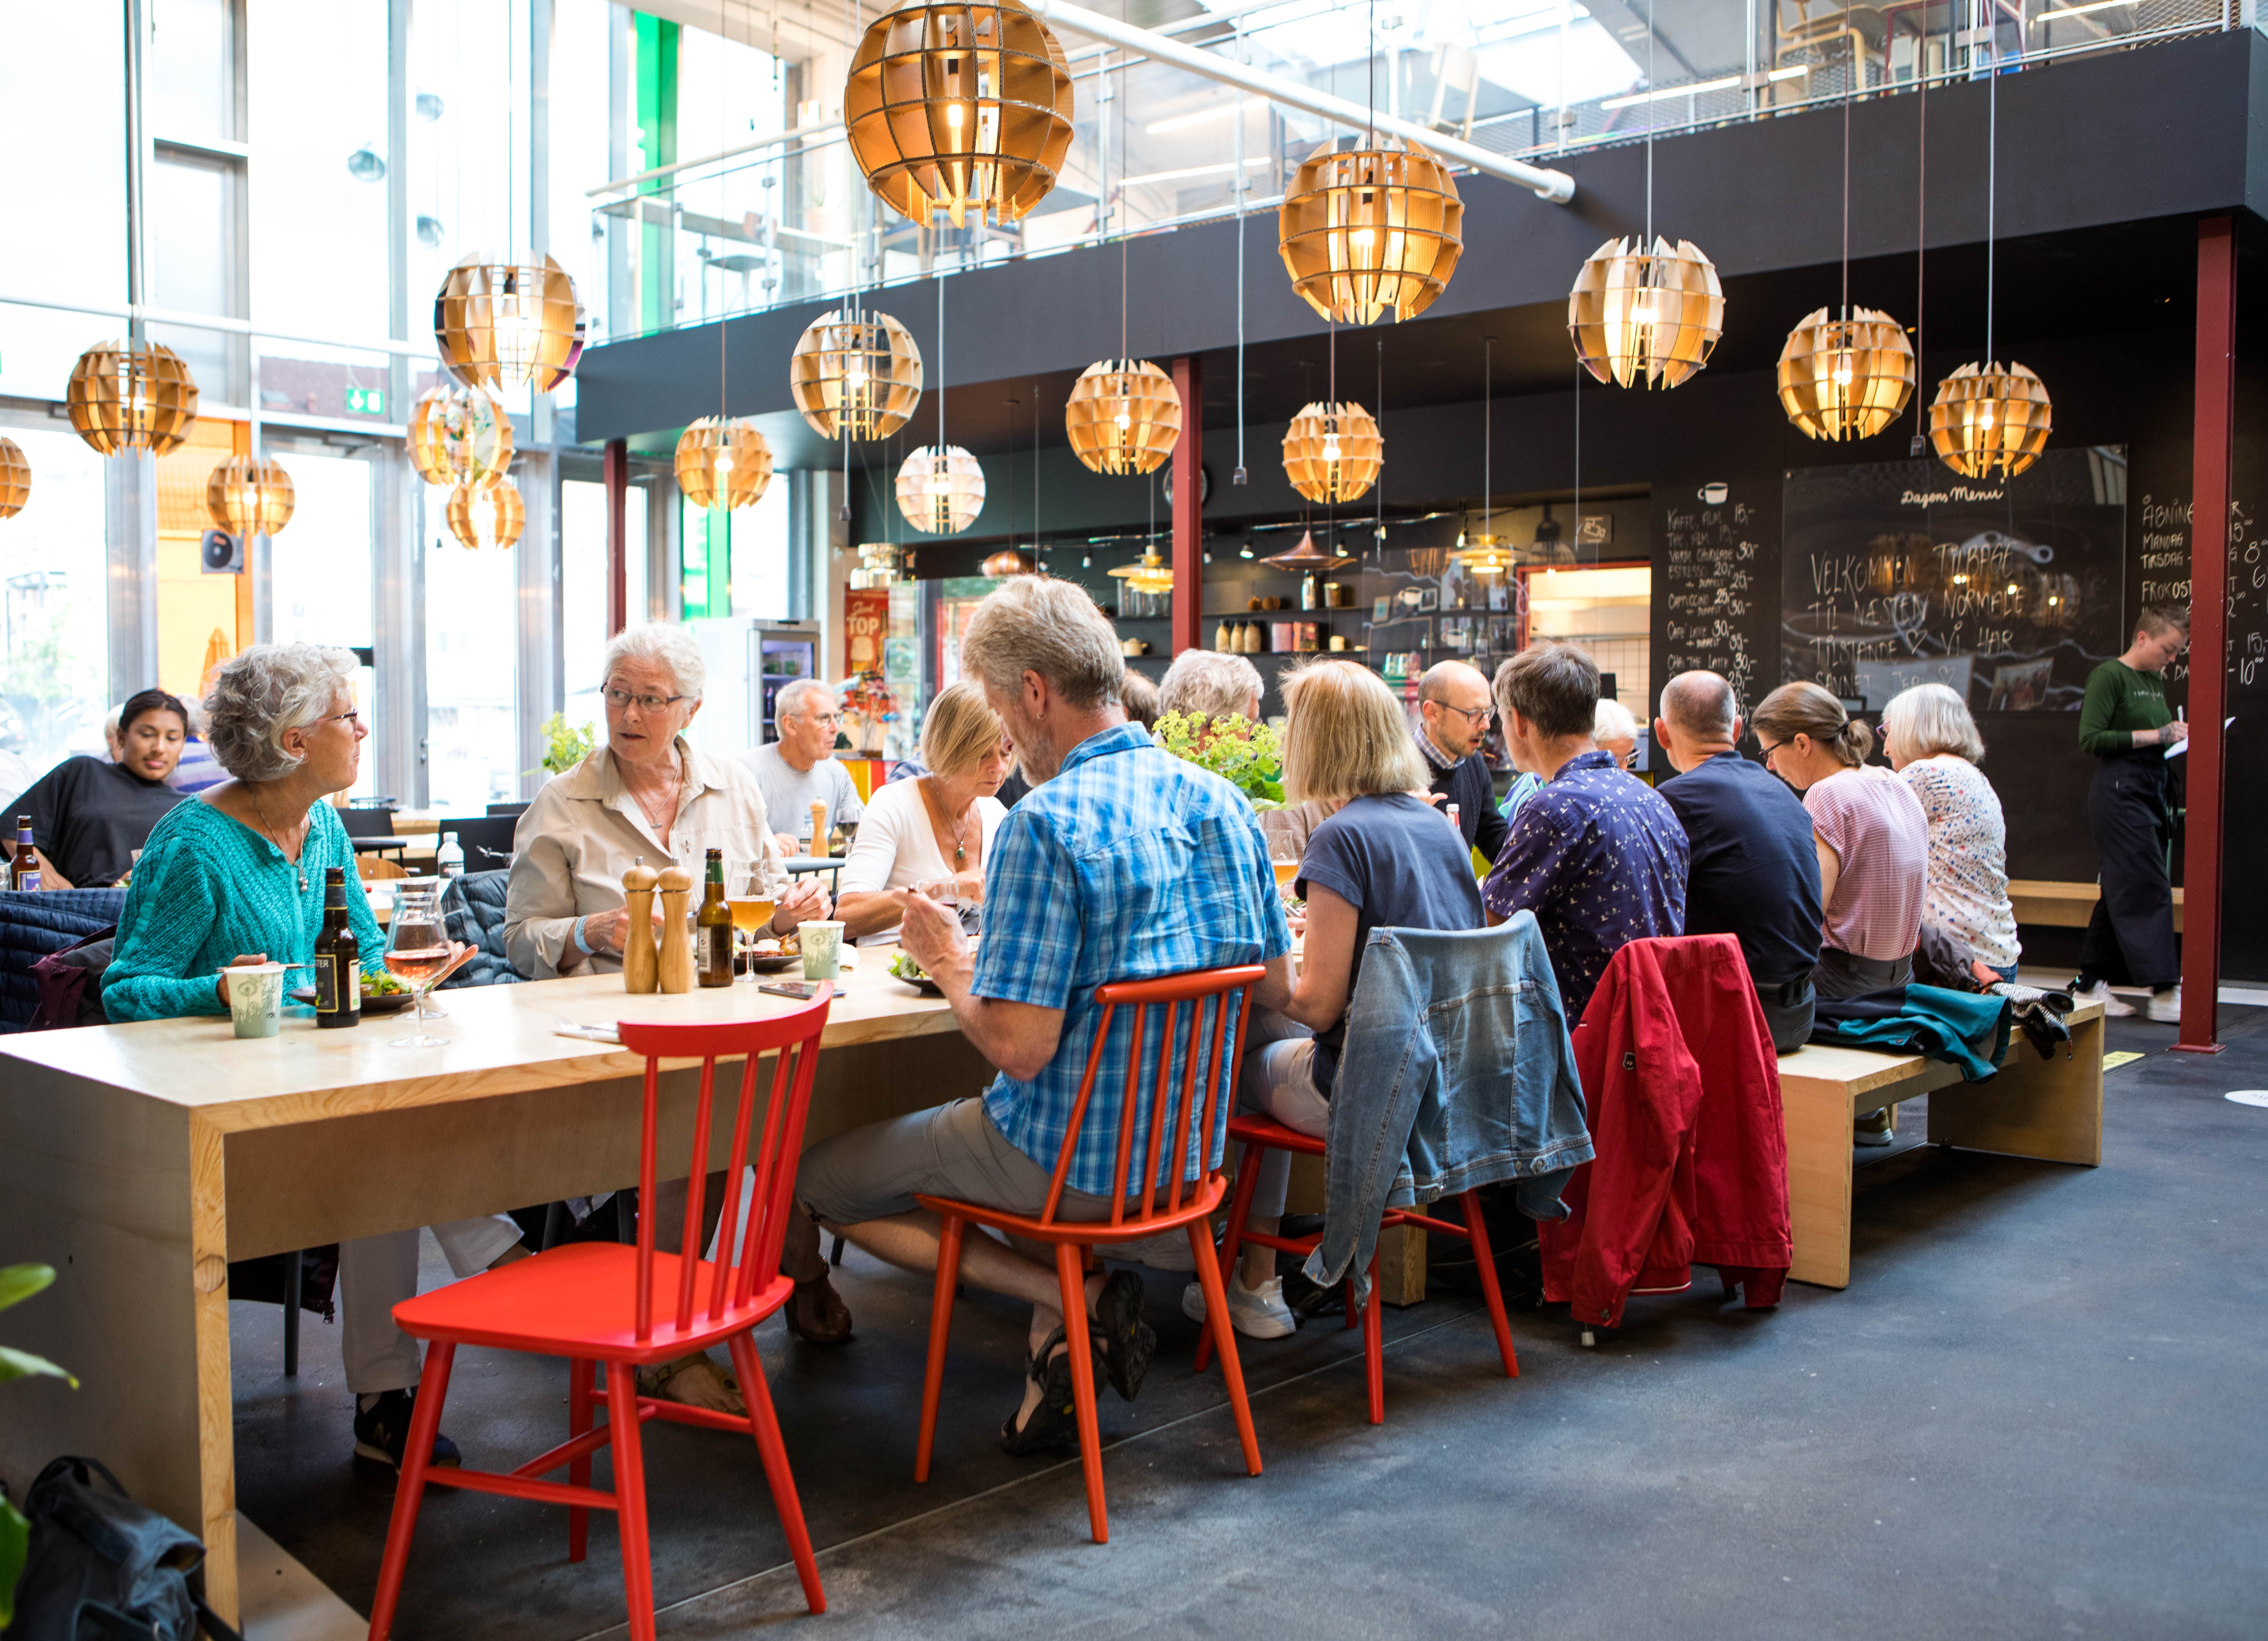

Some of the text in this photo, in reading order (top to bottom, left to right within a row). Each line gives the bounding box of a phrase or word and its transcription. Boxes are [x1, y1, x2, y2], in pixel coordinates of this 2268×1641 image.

[1901, 486, 2004, 509] Dagens Menu
[2143, 532, 2183, 551] MANDAG
[1811, 552, 1914, 597] VELKOMMEN
[847, 616, 880, 636] TOP
[1977, 627, 2014, 657] HAR
